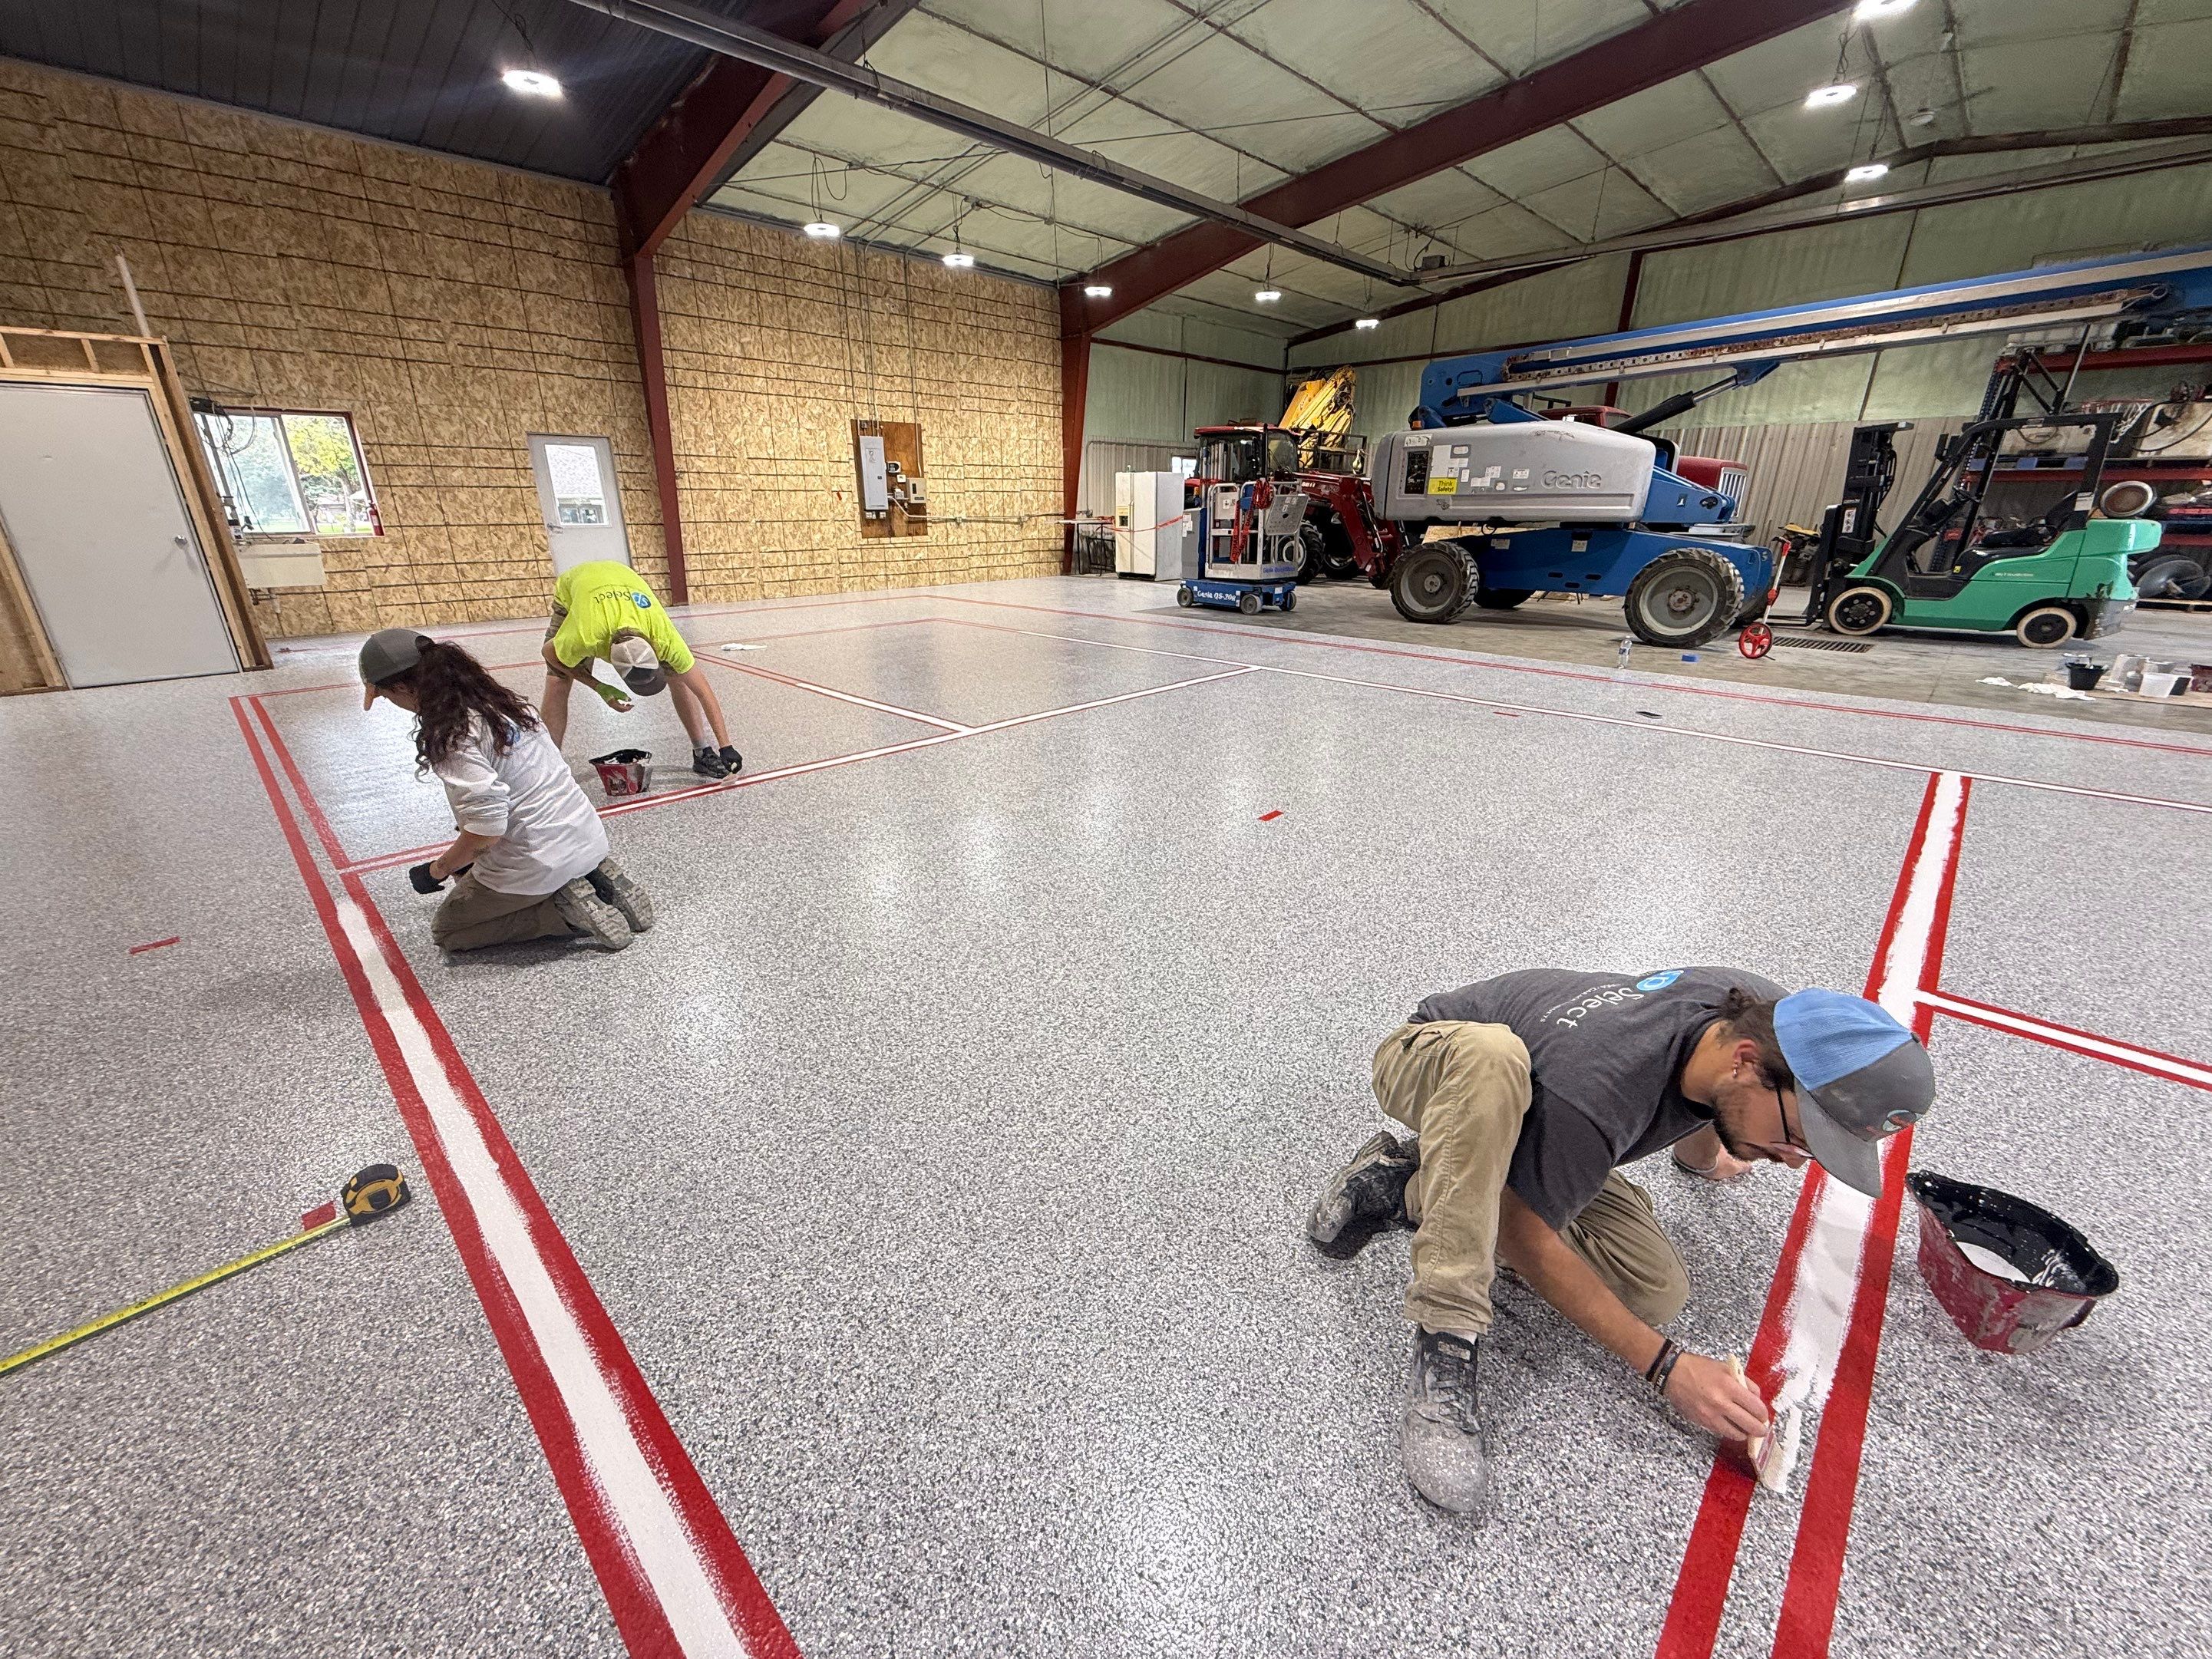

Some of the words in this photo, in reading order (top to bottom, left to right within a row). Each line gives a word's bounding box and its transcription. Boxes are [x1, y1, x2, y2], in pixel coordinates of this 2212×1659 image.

[1541, 470, 1602, 489] Genie
[593, 591, 631, 604] Select
[1197, 590, 1213, 599] Genie
[1213, 592, 1236, 602] QS-20R
[1556, 987, 1645, 1028] Select
